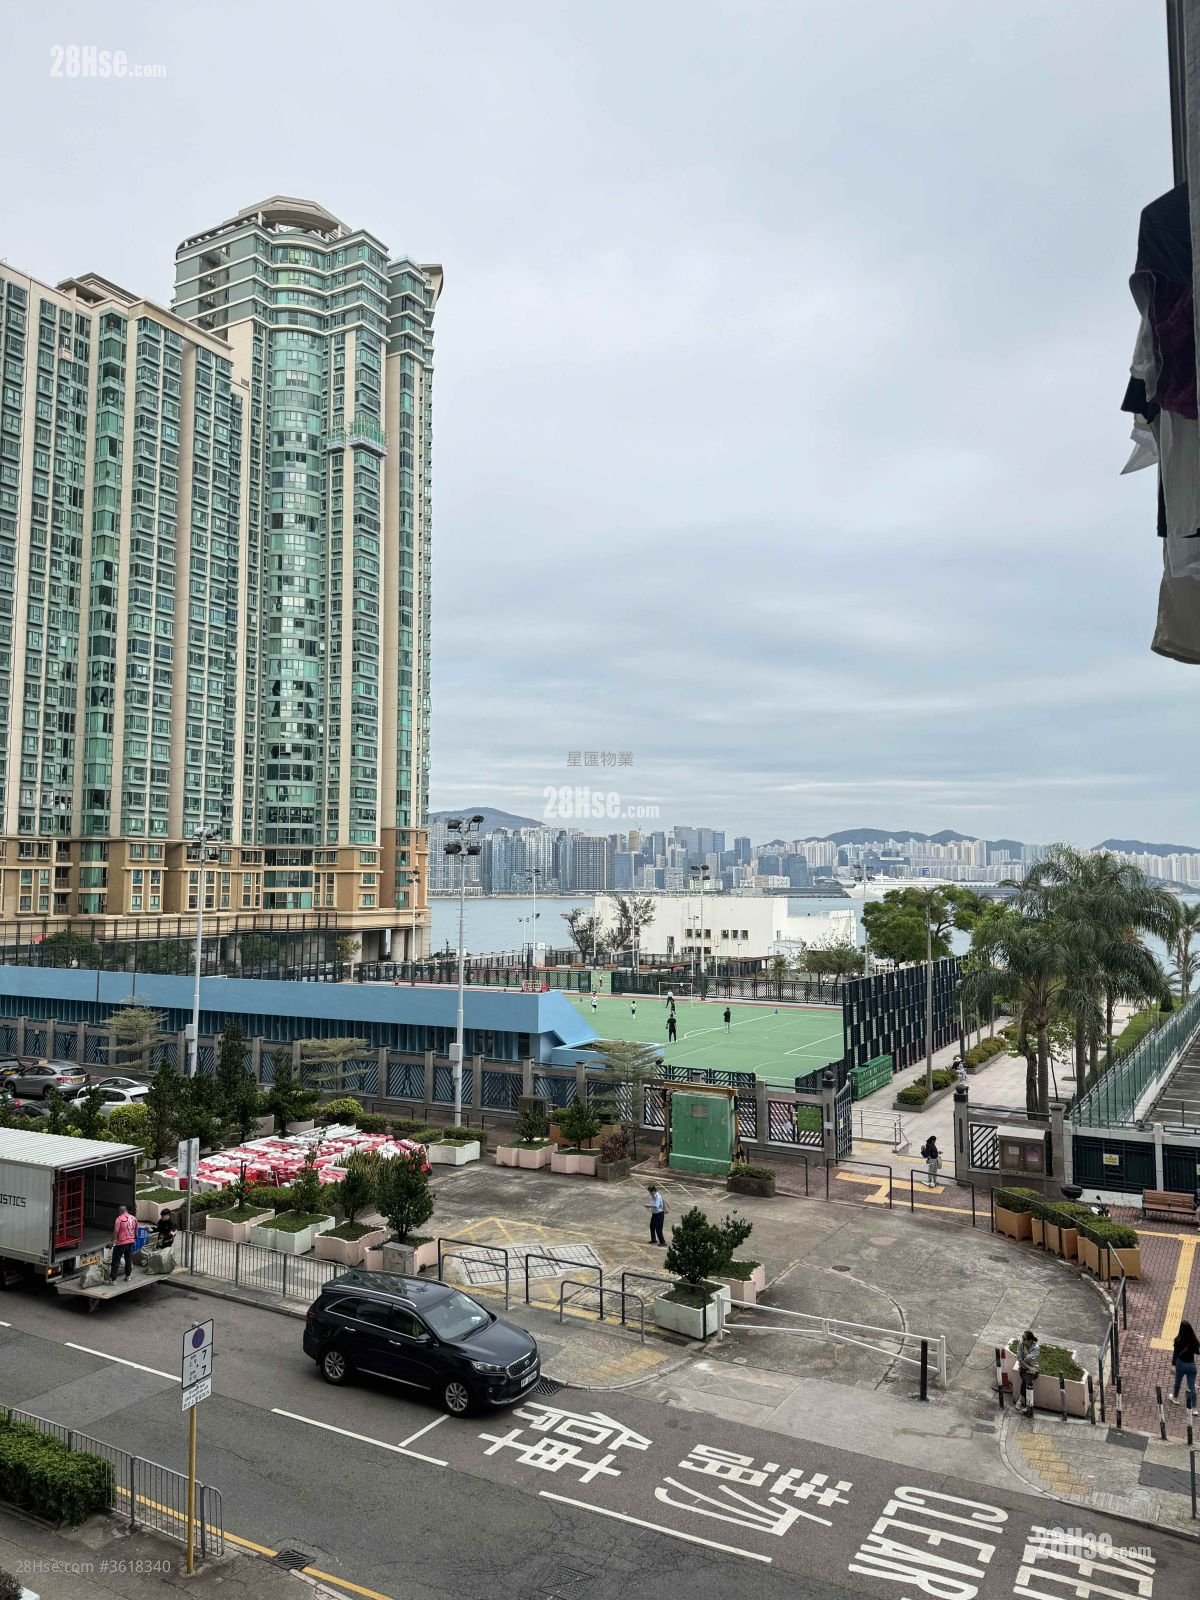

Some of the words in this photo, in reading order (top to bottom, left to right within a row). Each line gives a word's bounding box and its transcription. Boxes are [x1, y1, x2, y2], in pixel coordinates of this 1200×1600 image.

[201, 1364, 207, 1375] 7
[202, 1349, 207, 1360] 7
[848, 1486, 1009, 1600] CLEAR
[1013, 1525, 1157, 1600] KEE
